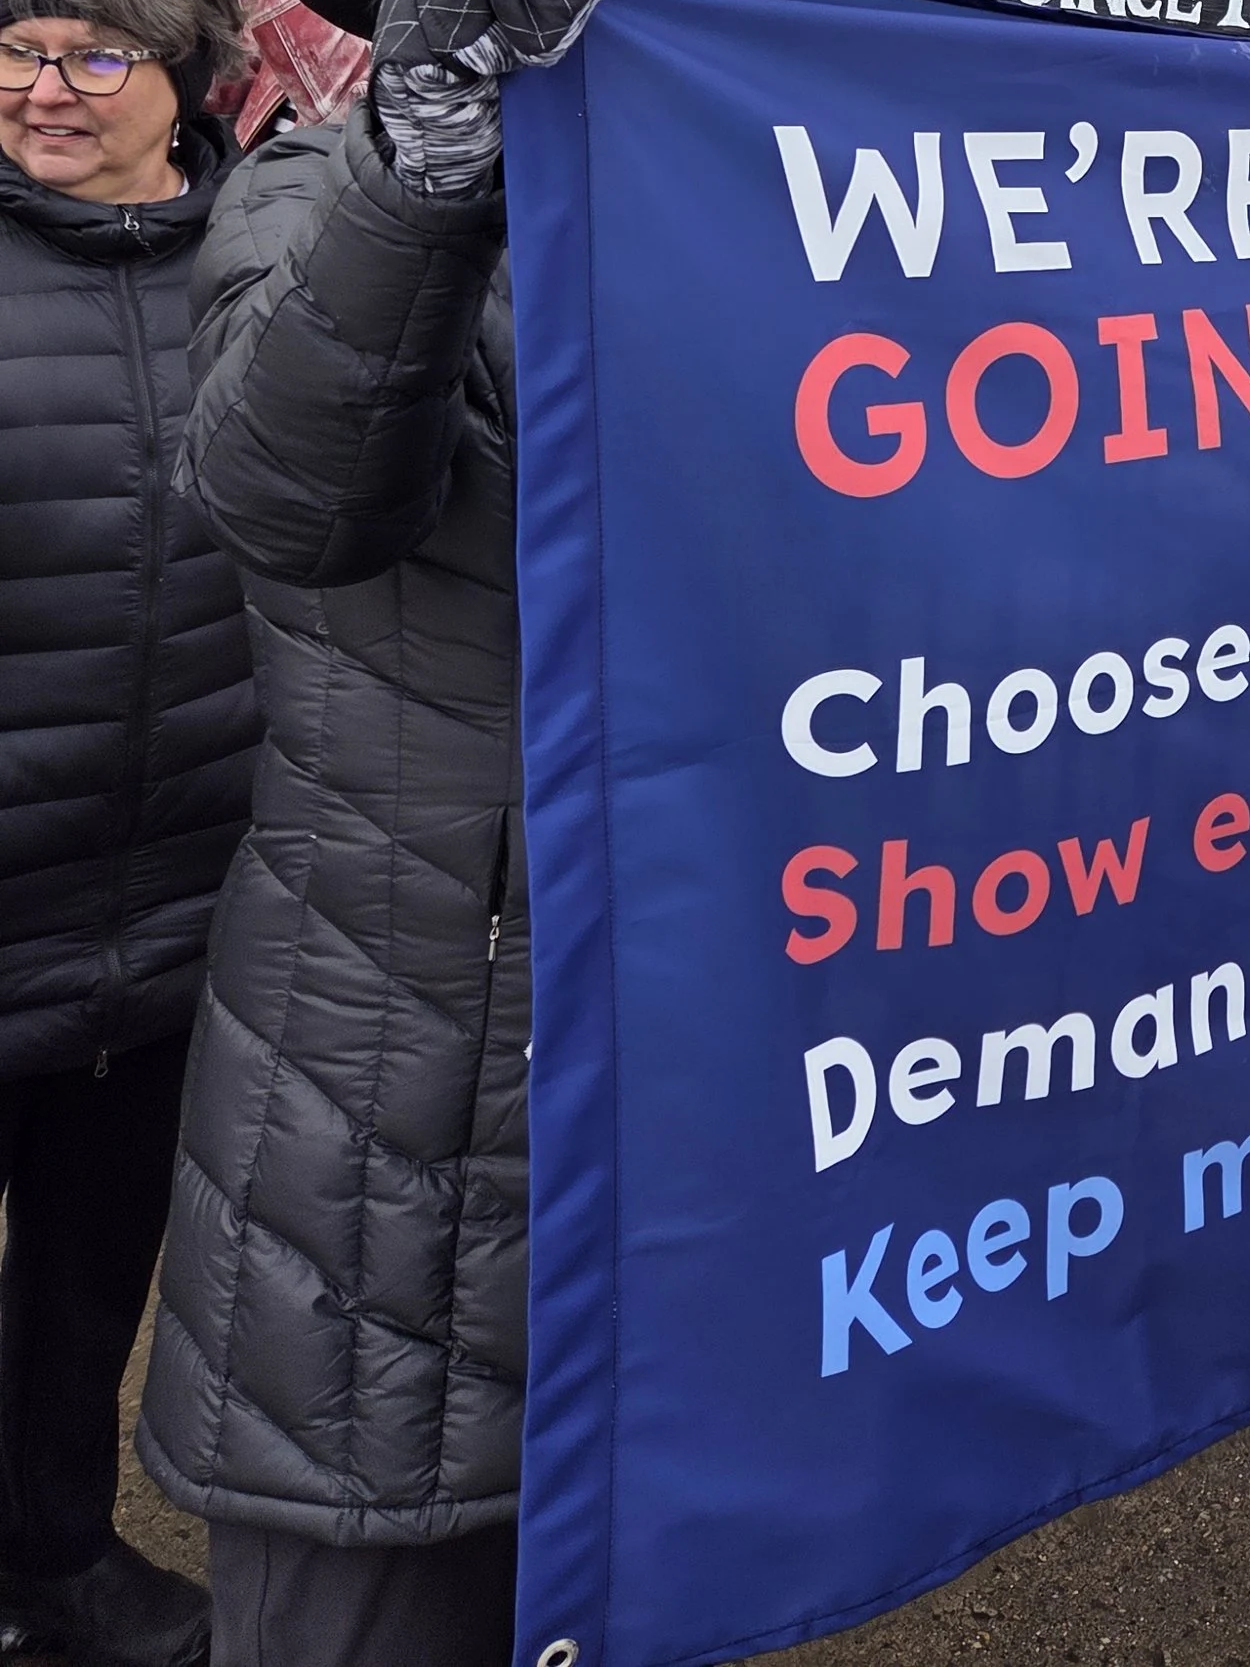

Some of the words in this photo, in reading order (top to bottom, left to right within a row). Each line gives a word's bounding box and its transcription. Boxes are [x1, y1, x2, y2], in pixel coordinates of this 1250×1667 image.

[782, 625, 1250, 777] Choose
[782, 817, 1149, 964] Show
[822, 1177, 1123, 1377] Keep
